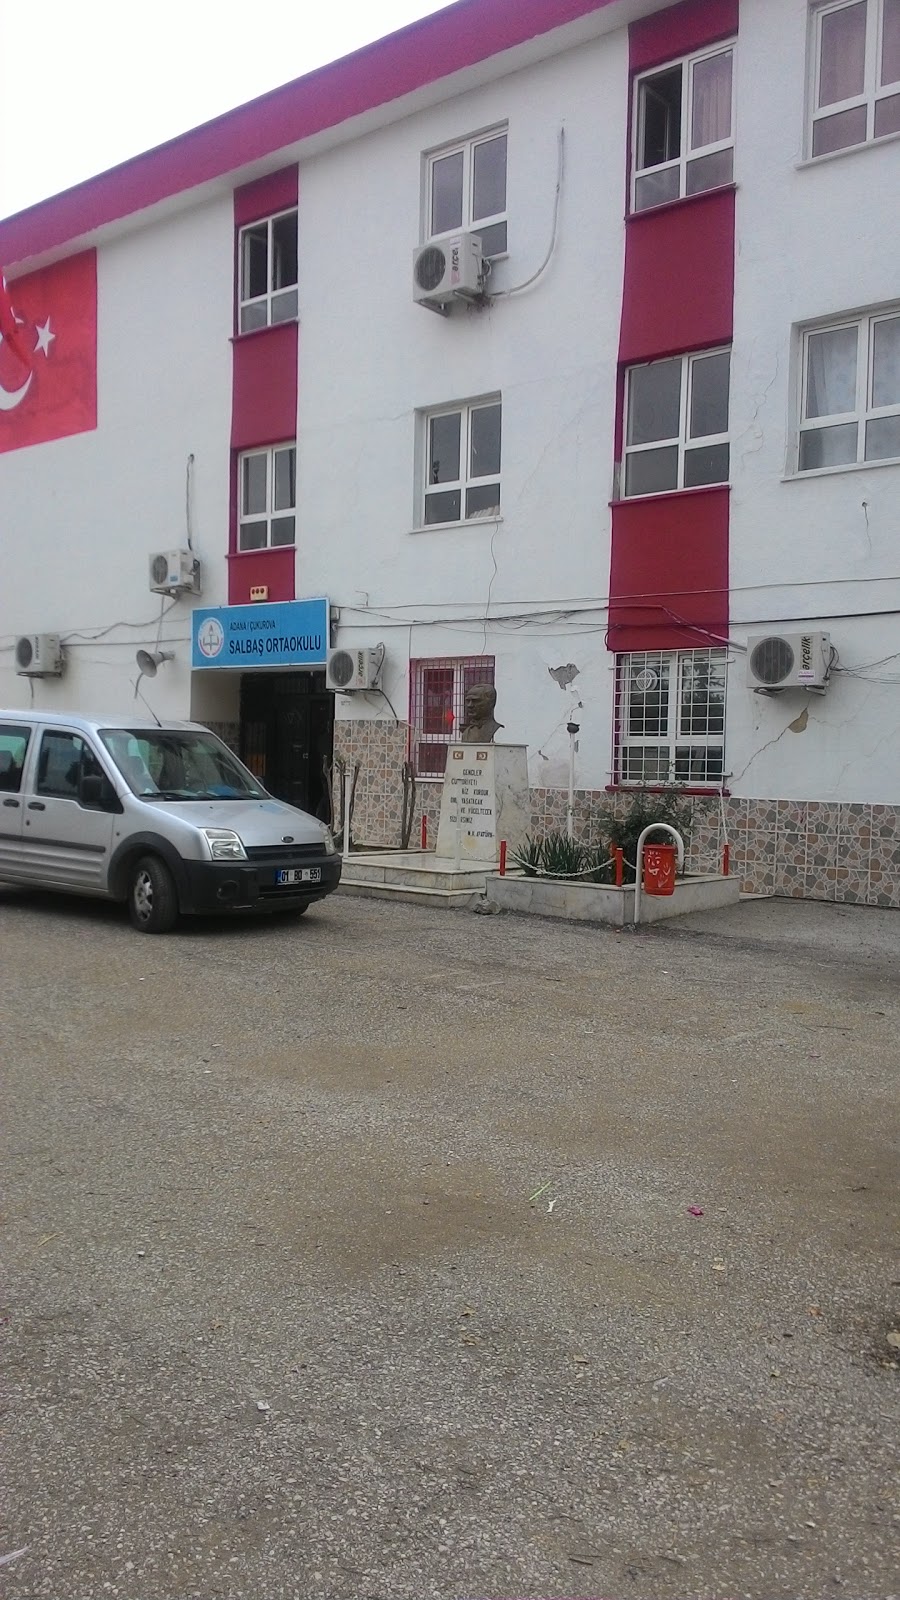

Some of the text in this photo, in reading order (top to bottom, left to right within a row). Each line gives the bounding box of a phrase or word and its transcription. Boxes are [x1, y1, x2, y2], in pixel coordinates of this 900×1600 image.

[230, 621, 247, 631] ADANA
[250, 620, 276, 631] ÇUKUROVA
[229, 635, 321, 656] SALBAŞ ORTAOKULU
[801, 636, 812, 670] arçelik
[281, 871, 289, 881] 01
